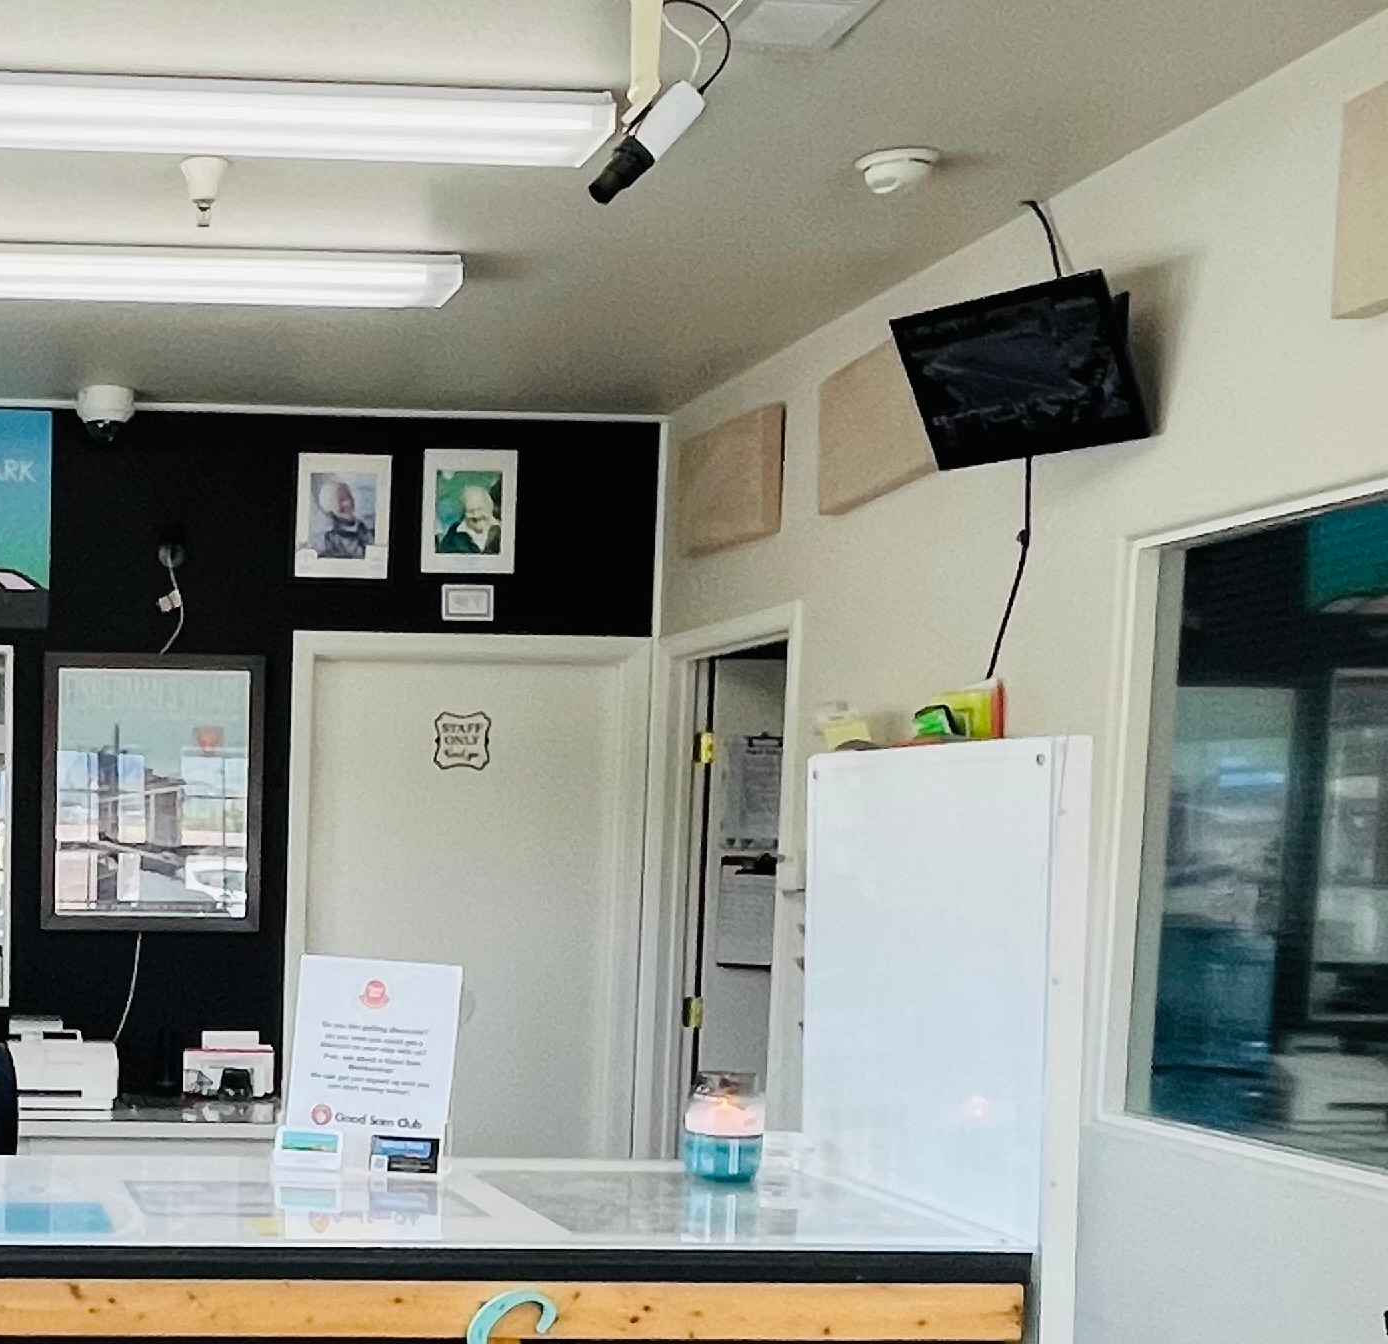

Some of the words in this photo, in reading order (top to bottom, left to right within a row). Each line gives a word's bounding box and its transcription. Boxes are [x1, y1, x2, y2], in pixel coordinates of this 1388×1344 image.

[335, 1112, 367, 1125] Good
[370, 1115, 394, 1127] Sam
[397, 1118, 423, 1130] Club
